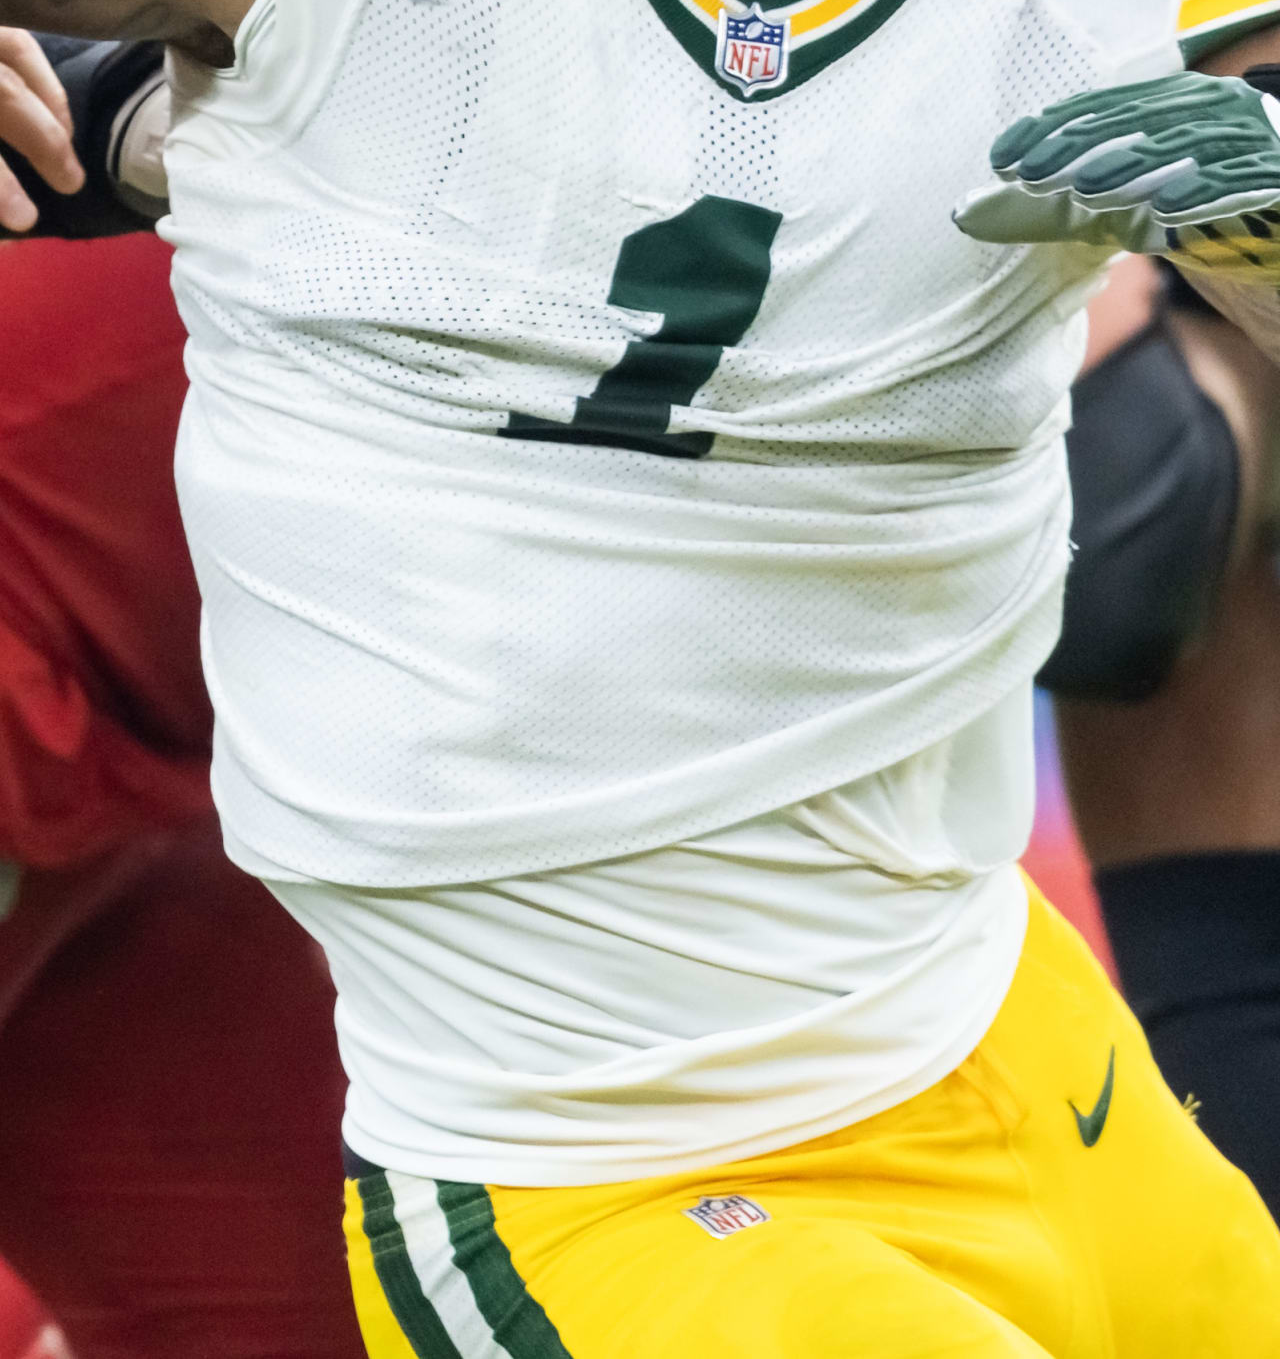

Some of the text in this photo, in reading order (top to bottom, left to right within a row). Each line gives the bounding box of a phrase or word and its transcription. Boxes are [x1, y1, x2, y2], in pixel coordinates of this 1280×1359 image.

[727, 41, 776, 79] NFL
[496, 194, 784, 459] 1
[709, 1206, 761, 1231] NFL
